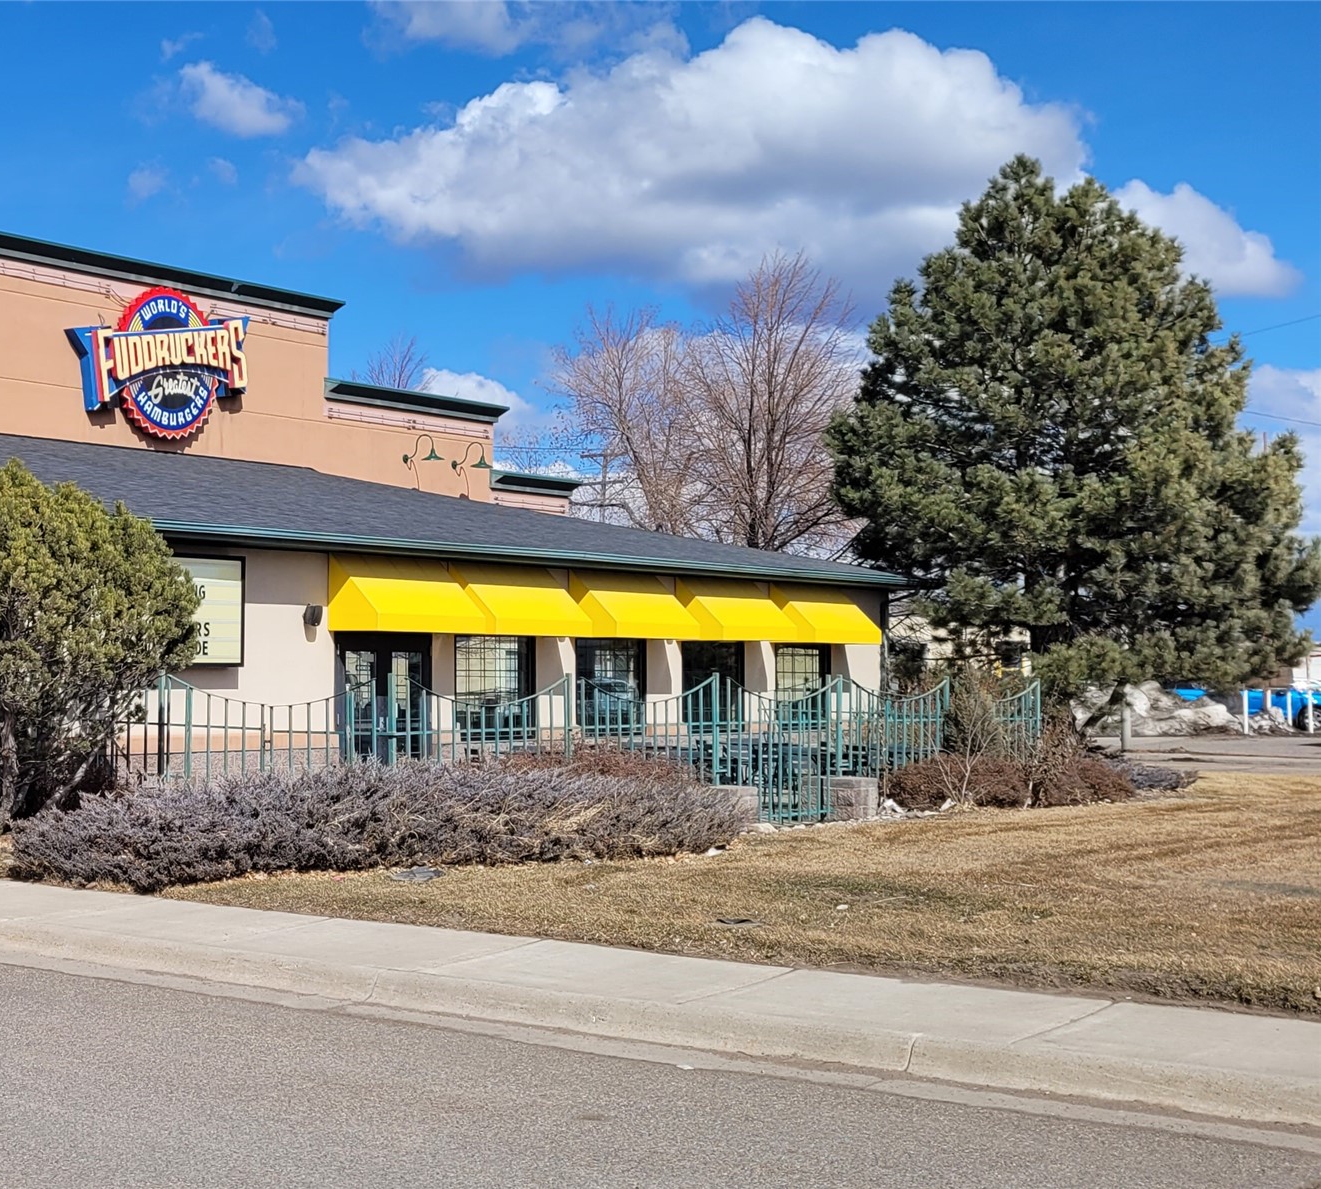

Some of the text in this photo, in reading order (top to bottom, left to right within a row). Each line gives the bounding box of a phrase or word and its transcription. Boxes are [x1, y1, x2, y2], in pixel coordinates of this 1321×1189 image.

[141, 298, 188, 321] WORLD'S
[97, 319, 248, 402] FUDDRUCKERS
[148, 372, 201, 404] Greatest
[137, 386, 208, 427] HAMBURGERS
